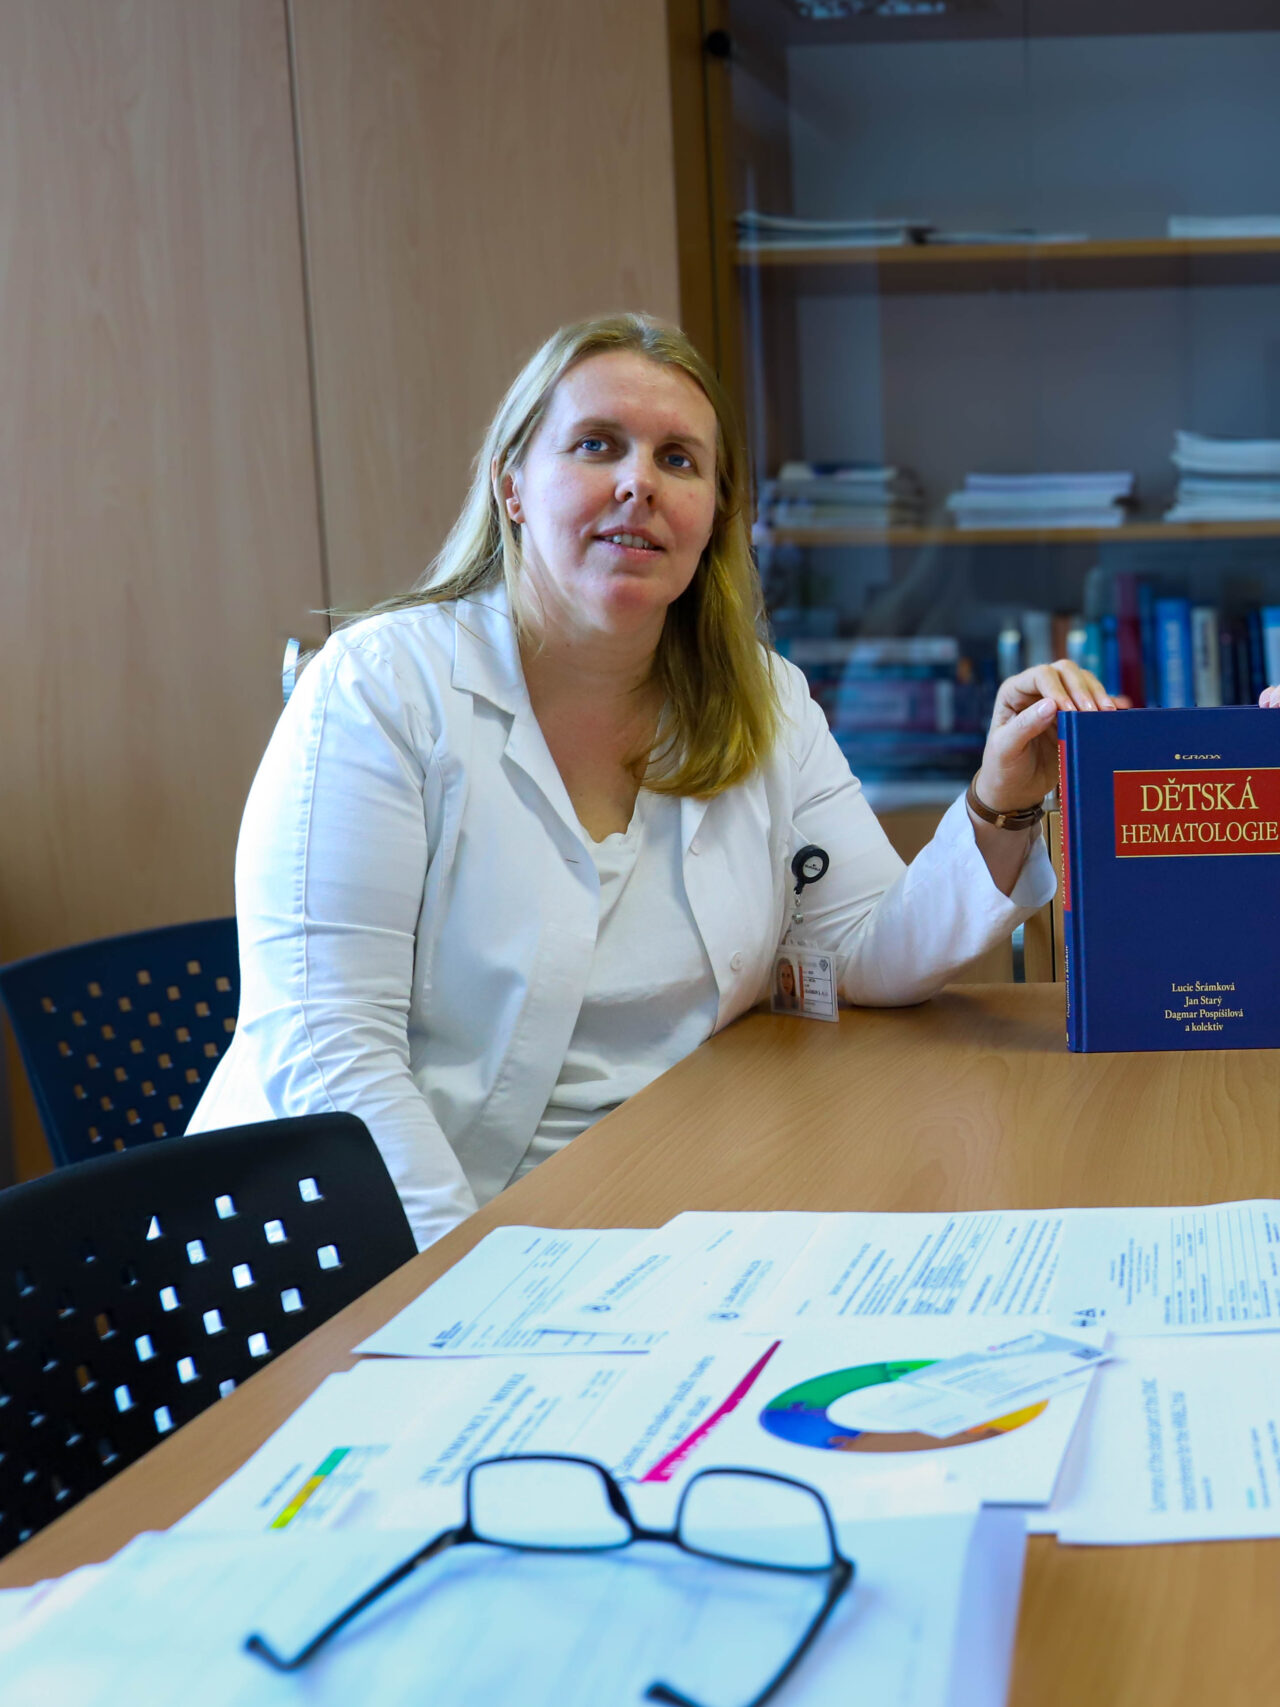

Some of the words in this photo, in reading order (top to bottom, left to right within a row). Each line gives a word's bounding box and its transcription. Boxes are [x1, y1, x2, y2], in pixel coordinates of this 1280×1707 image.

[1181, 752, 1222, 761] GRADA
[1139, 775, 1260, 812] DĚTSKÁ
[1120, 820, 1280, 844] HEMATOLOGIE
[1171, 983, 1194, 993] Lucie
[1195, 981, 1236, 993] Šrámková
[1184, 996, 1199, 1008] Jan
[1200, 996, 1223, 1007] Starý
[1164, 1009, 1198, 1021] Dagmar
[1199, 1008, 1244, 1020] Pospíšilová
[1191, 1022, 1224, 1032] kolektiv
